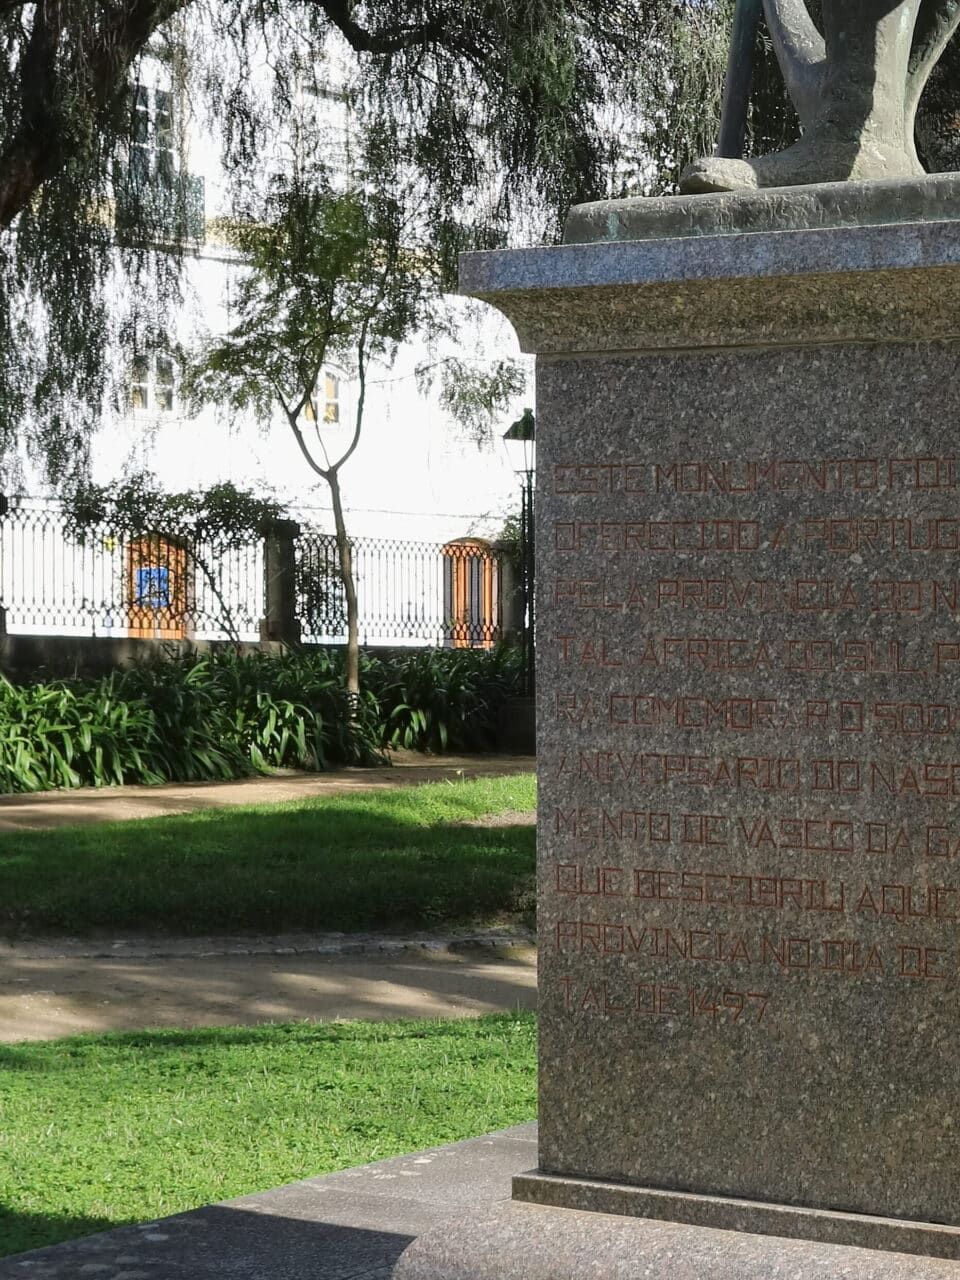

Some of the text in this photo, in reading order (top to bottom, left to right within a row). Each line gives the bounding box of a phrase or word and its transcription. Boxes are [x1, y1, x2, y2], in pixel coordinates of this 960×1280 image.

[553, 456, 957, 493] ESTE MONUMENTO FOI
[553, 521, 760, 551] OFERECIDO
[553, 578, 646, 610] PELA
[656, 579, 860, 612] PROVINCIA
[871, 581, 921, 612] DO
[785, 640, 835, 672] DO
[556, 693, 599, 721] RA
[608, 695, 829, 732] COMEMORAR
[840, 701, 863, 733] O
[556, 752, 797, 790] ANIVERSARIO
[811, 760, 861, 792] DO
[554, 807, 672, 842] MENTO
[682, 814, 729, 846] DE
[740, 819, 856, 852] VASCO
[865, 822, 911, 854] DA
[555, 864, 624, 896] QUE
[633, 869, 845, 912] DESCOBRIU
[555, 920, 751, 964] PROVINCIA
[762, 937, 810, 969] NO
[821, 940, 885, 976] DIA
[898, 945, 944, 979] DE
[558, 976, 771, 1023] TAL DE 1497
